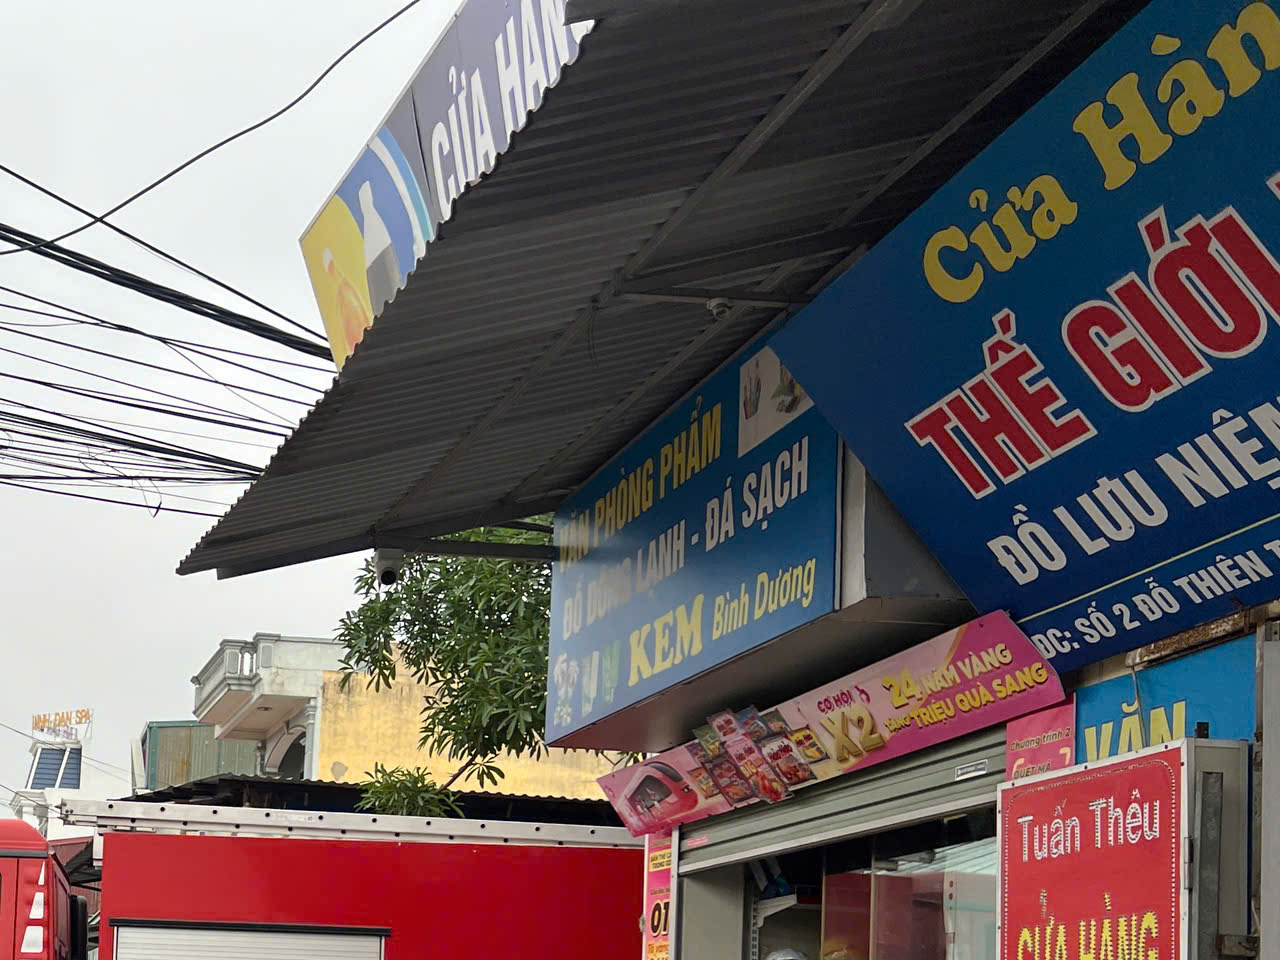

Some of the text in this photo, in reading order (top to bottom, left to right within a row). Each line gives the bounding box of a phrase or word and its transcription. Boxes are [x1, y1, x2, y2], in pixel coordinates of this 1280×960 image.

[431, 0, 595, 224] CỬA HÀN
[923, 174, 1078, 303] Cửa
[904, 204, 1280, 500] THẾ GIỚI
[593, 457, 654, 548] PHÒNG
[658, 395, 722, 500] PHẨM
[636, 519, 686, 601] LẠNH
[705, 476, 735, 553] ĐÁ
[741, 435, 809, 531] SẠCH
[986, 504, 1067, 586] ĐỒ
[1052, 470, 1169, 556] LƯU
[628, 557, 816, 687] KEM Bình Dương
[1074, 601, 1117, 644] SỐ
[1112, 602, 1142, 631] 2
[1173, 550, 1274, 604] THIÊN
[883, 671, 921, 709] 24
[957, 643, 1013, 680] VÀNG
[910, 698, 956, 729] TRIỆU
[957, 682, 995, 712] QUÀ
[992, 662, 1048, 699] SANG
[1084, 699, 1186, 764] VĂN
[1017, 788, 1160, 862] Tuấn Thêu
[650, 900, 670, 937] 01
